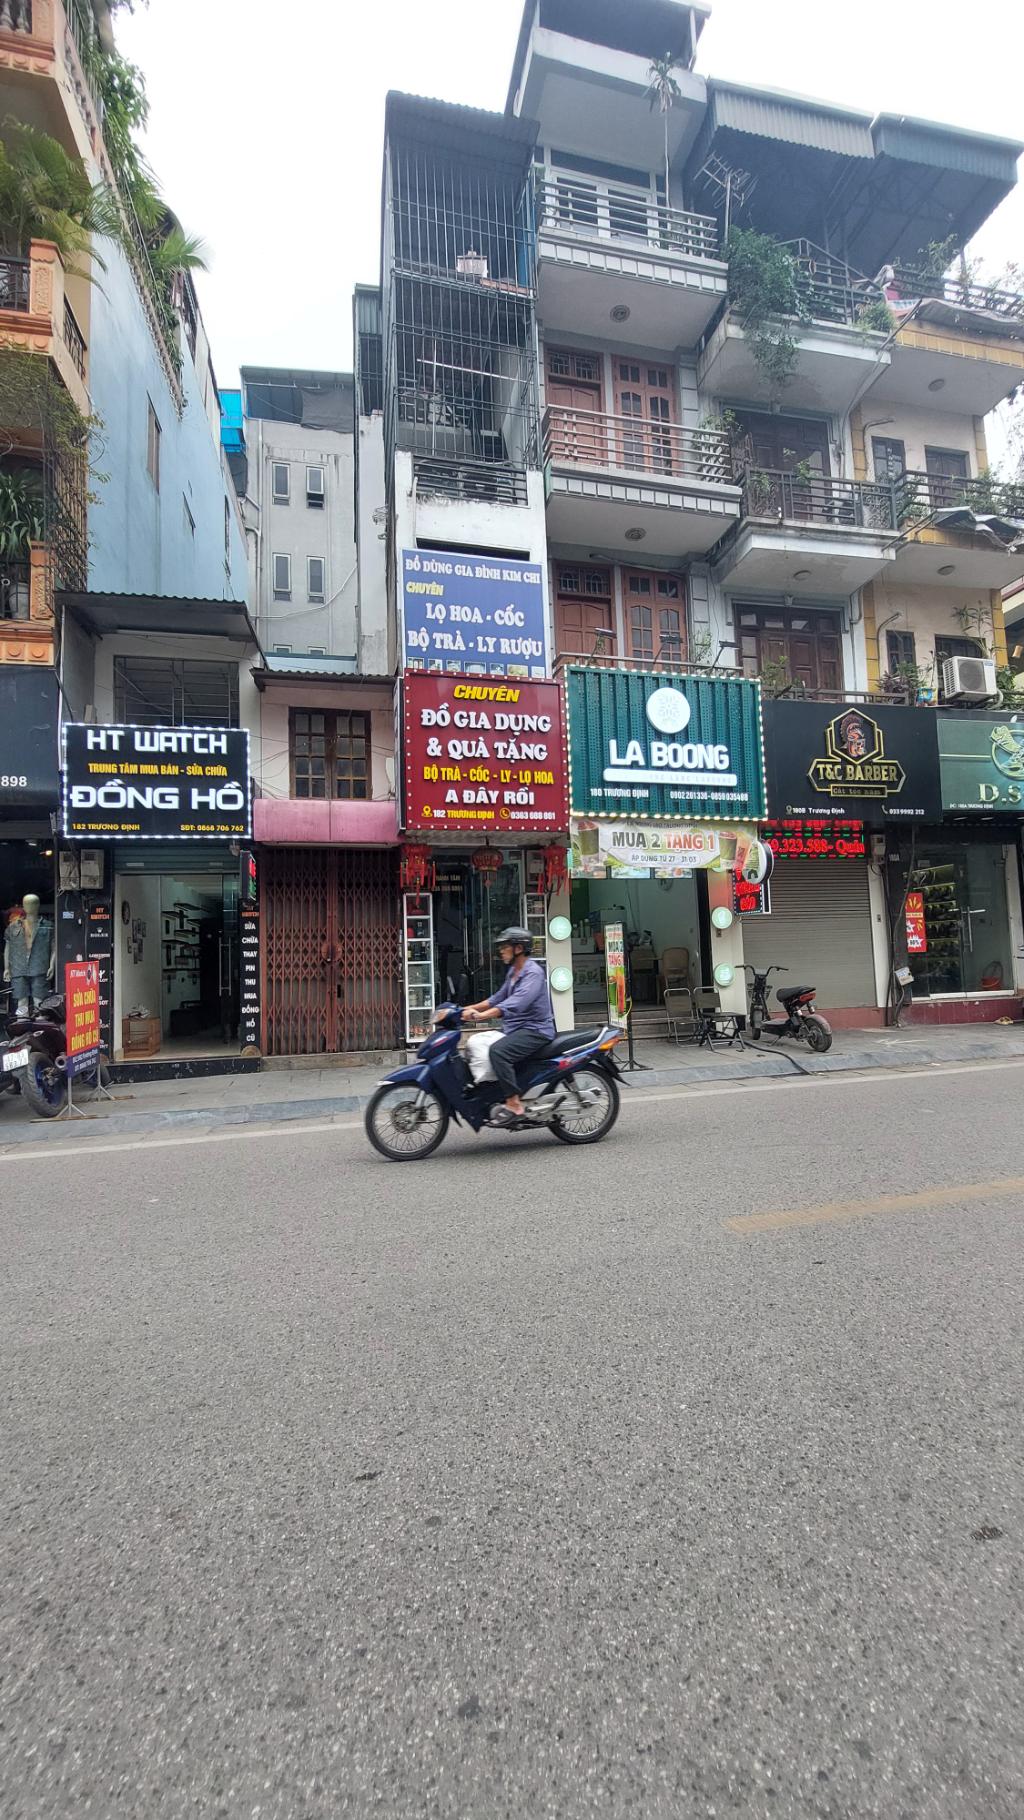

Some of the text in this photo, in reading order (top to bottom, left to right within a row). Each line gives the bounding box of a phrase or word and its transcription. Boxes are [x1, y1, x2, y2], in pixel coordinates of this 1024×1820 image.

[406, 555, 541, 584] ĐỒ DÙNG GIA ĐÌNH KIM CHI
[406, 581, 444, 596] CHUYÊN
[426, 603, 446, 624] LỌ
[449, 605, 483, 624] HOA
[494, 604, 524, 627] CỐC
[408, 627, 430, 652] BỘ
[433, 630, 466, 650] TRÀ
[477, 636, 497, 653] LY
[500, 637, 543, 660] RƯỢU
[453, 684, 520, 703] CHUYÊN
[421, 702, 552, 736] ĐỒ GIA DỤNG
[86, 730, 228, 754] HT WATCH
[426, 736, 548, 763] & QUÀ TẶNG
[609, 739, 729, 769] LA BOONG
[88, 762, 117, 774] TRUNG
[119, 762, 138, 775] TÂM
[140, 764, 159, 775] MUA
[161, 762, 179, 776] BÁN
[186, 762, 204, 777] SỬA
[205, 763, 228, 777] CHỮA
[424, 764, 439, 783] BỘ
[440, 765, 461, 782] TRÀ
[469, 765, 490, 783] CỐC
[500, 770, 511, 783] LY
[519, 770, 532, 786] LỌ
[534, 771, 554, 785] HOA
[817, 763, 898, 782] T&C BARBER
[1, 776, 27, 787] 898
[69, 778, 244, 811] ĐỒNG HỒ
[445, 787, 535, 805] A ĐÂY RỒI
[72, 823, 86, 831] 182
[612, 832, 646, 848] MUA
[651, 834, 660, 849] 2
[708, 835, 715, 849] 1
